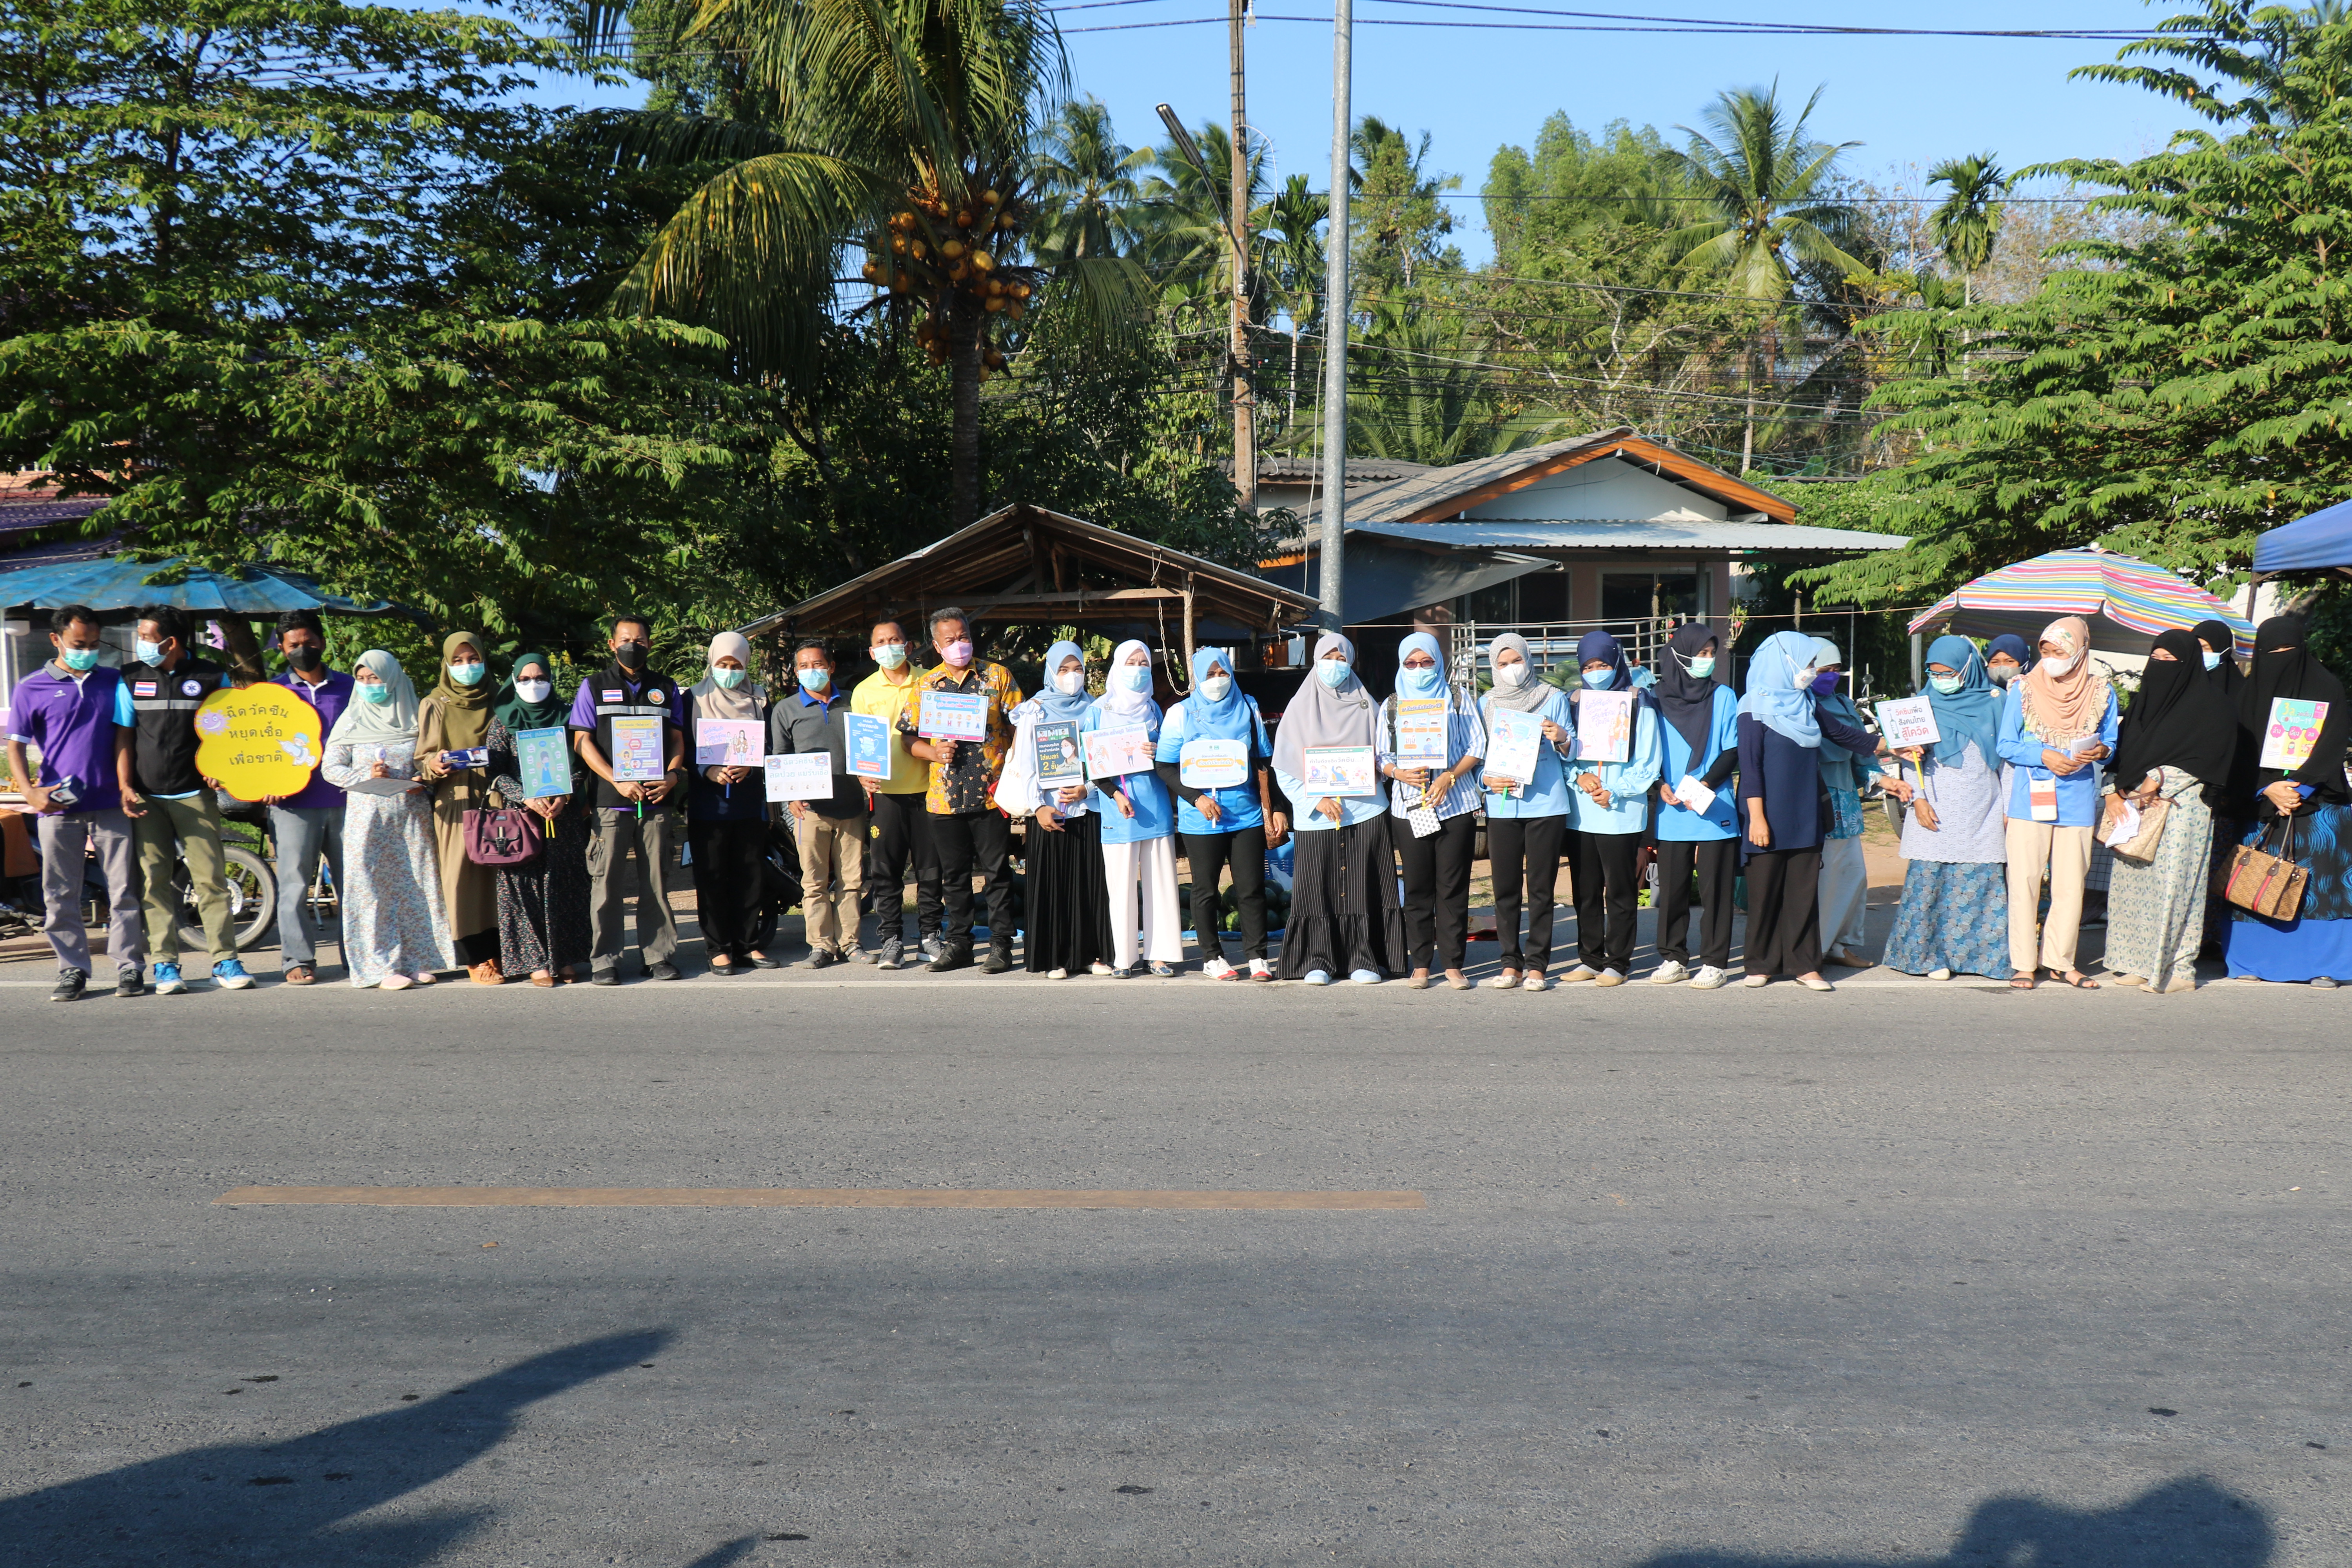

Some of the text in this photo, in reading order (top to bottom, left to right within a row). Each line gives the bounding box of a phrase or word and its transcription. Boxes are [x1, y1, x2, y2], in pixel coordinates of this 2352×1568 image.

[1895, 704, 1922, 716] วัคซีนเพื่อ
[1898, 716, 1925, 726] สังคมไทย
[229, 721, 282, 741] หยุดเชื้อ
[1902, 726, 1929, 741] สู้โควิด
[229, 750, 282, 765] เพื่อชาติ
[1043, 762, 1049, 771] 2
